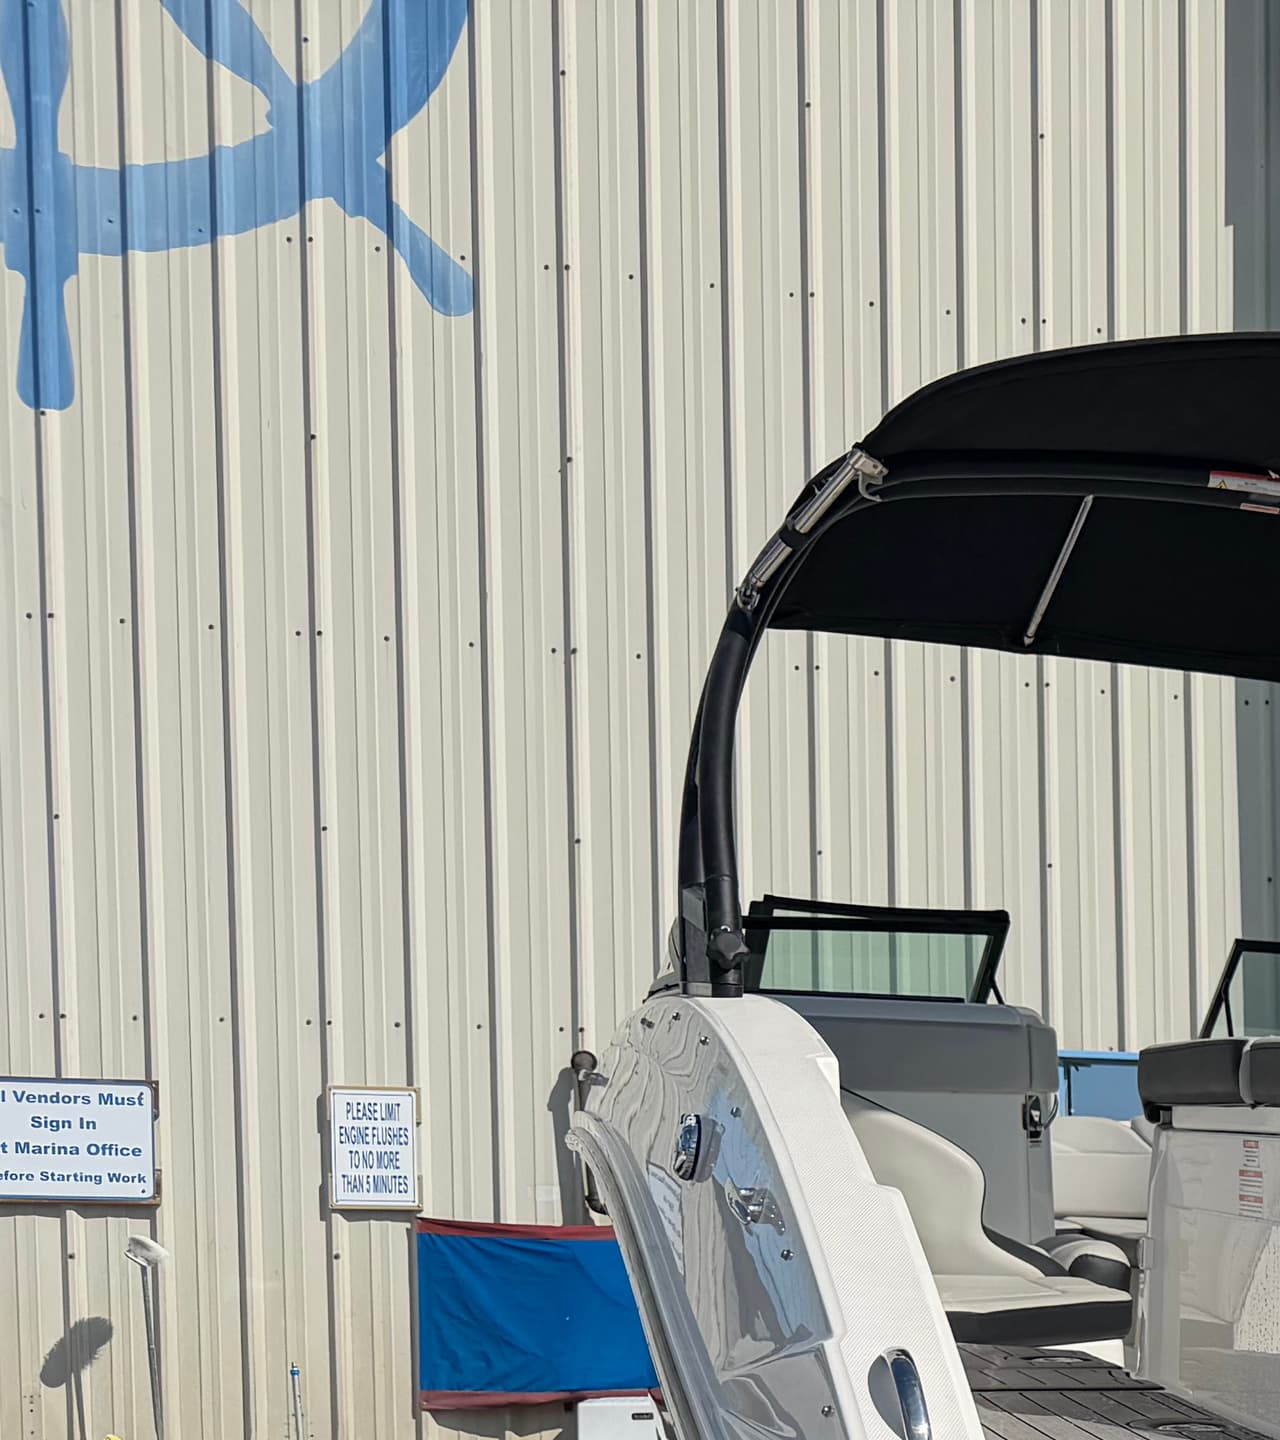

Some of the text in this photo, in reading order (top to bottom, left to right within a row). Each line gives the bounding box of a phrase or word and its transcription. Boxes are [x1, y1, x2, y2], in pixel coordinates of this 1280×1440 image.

[12, 1090, 91, 1105] Vendors
[98, 1092, 144, 1106] Must
[345, 1102, 401, 1121] PLEASE LIMIT
[30, 1116, 97, 1132] Sign In
[339, 1126, 409, 1146] ENGINE FLUSHES
[15, 1141, 80, 1155] Marina
[86, 1143, 142, 1156] Office
[348, 1150, 400, 1170] TO NO MORE
[39, 1171, 102, 1185] Starting
[107, 1172, 147, 1183] Work
[341, 1174, 409, 1194] THAN 5 MINUTES
